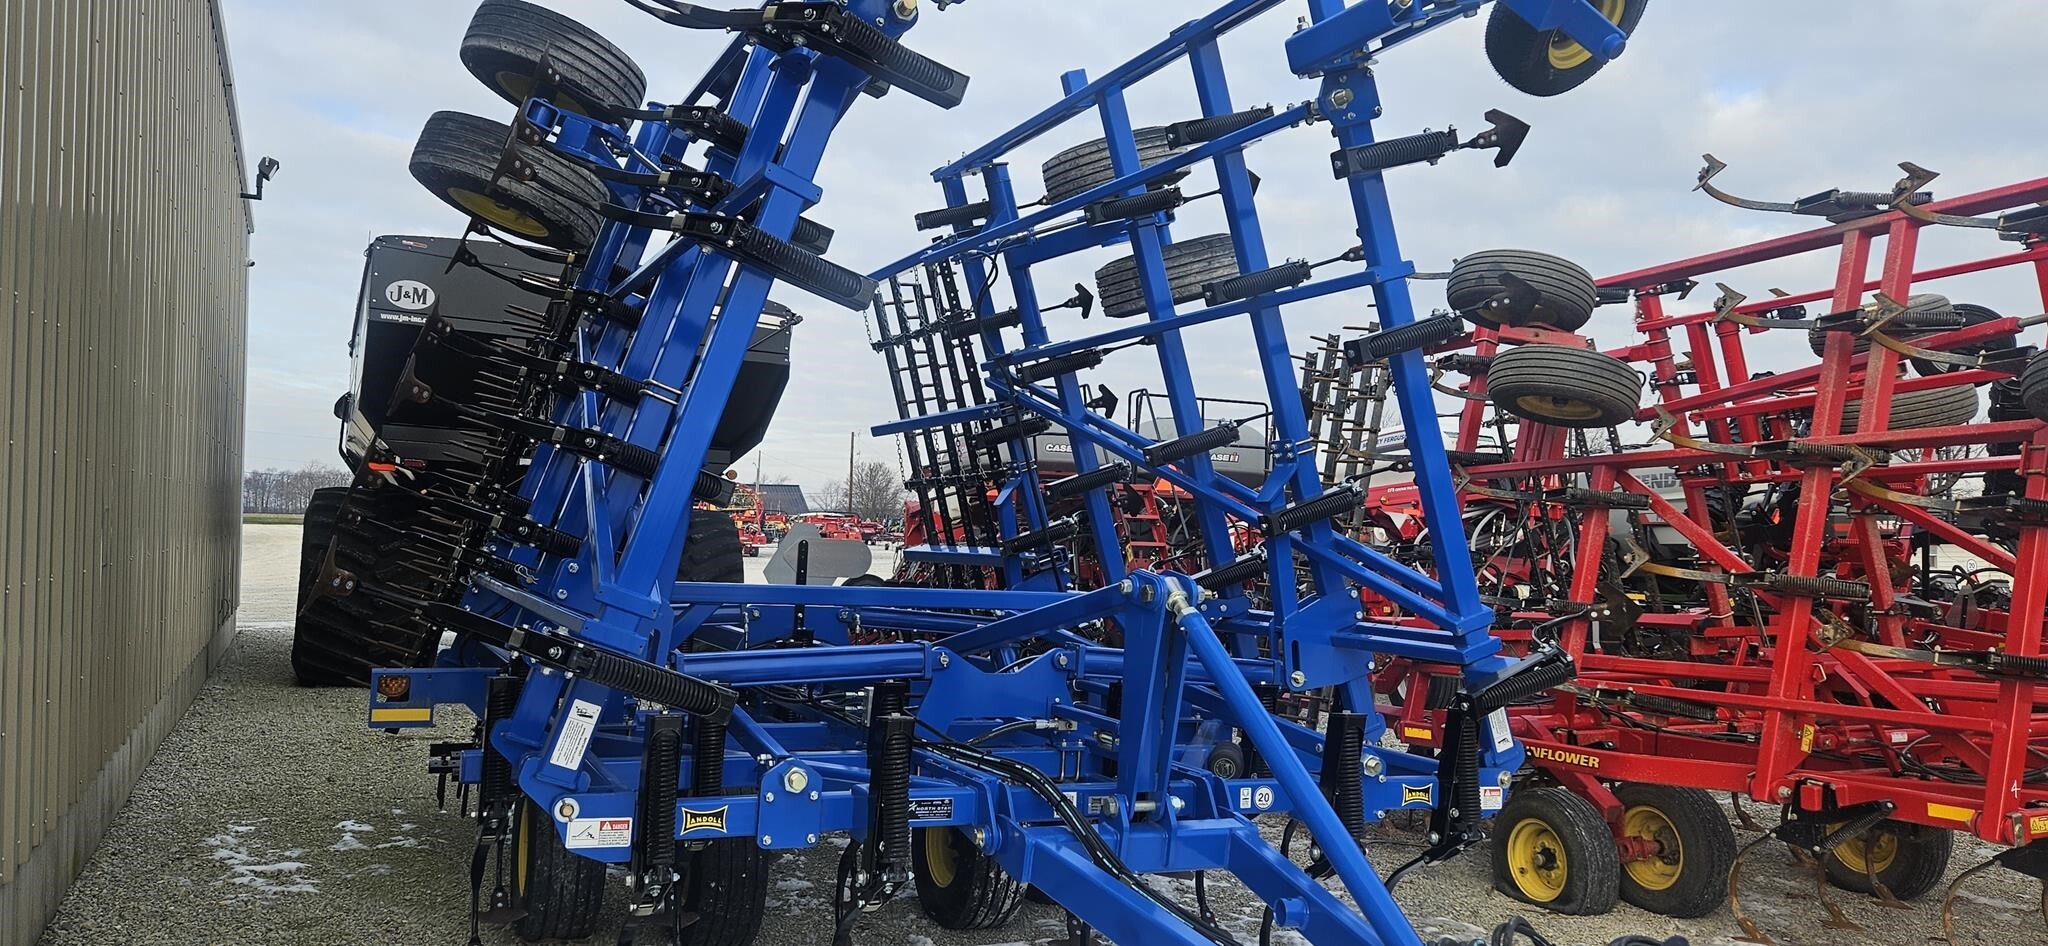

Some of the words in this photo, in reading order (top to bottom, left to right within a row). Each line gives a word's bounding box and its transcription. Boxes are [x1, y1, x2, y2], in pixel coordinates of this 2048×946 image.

[389, 285, 428, 305] J&M
[1046, 443, 1073, 453] CASE
[1211, 453, 1230, 461] ASE
[1635, 473, 1683, 488] END
[1529, 747, 1600, 768] NFLOWER
[2010, 779, 2021, 799] 4
[1258, 793, 1270, 803] 20
[686, 813, 722, 829] LANDOLL
